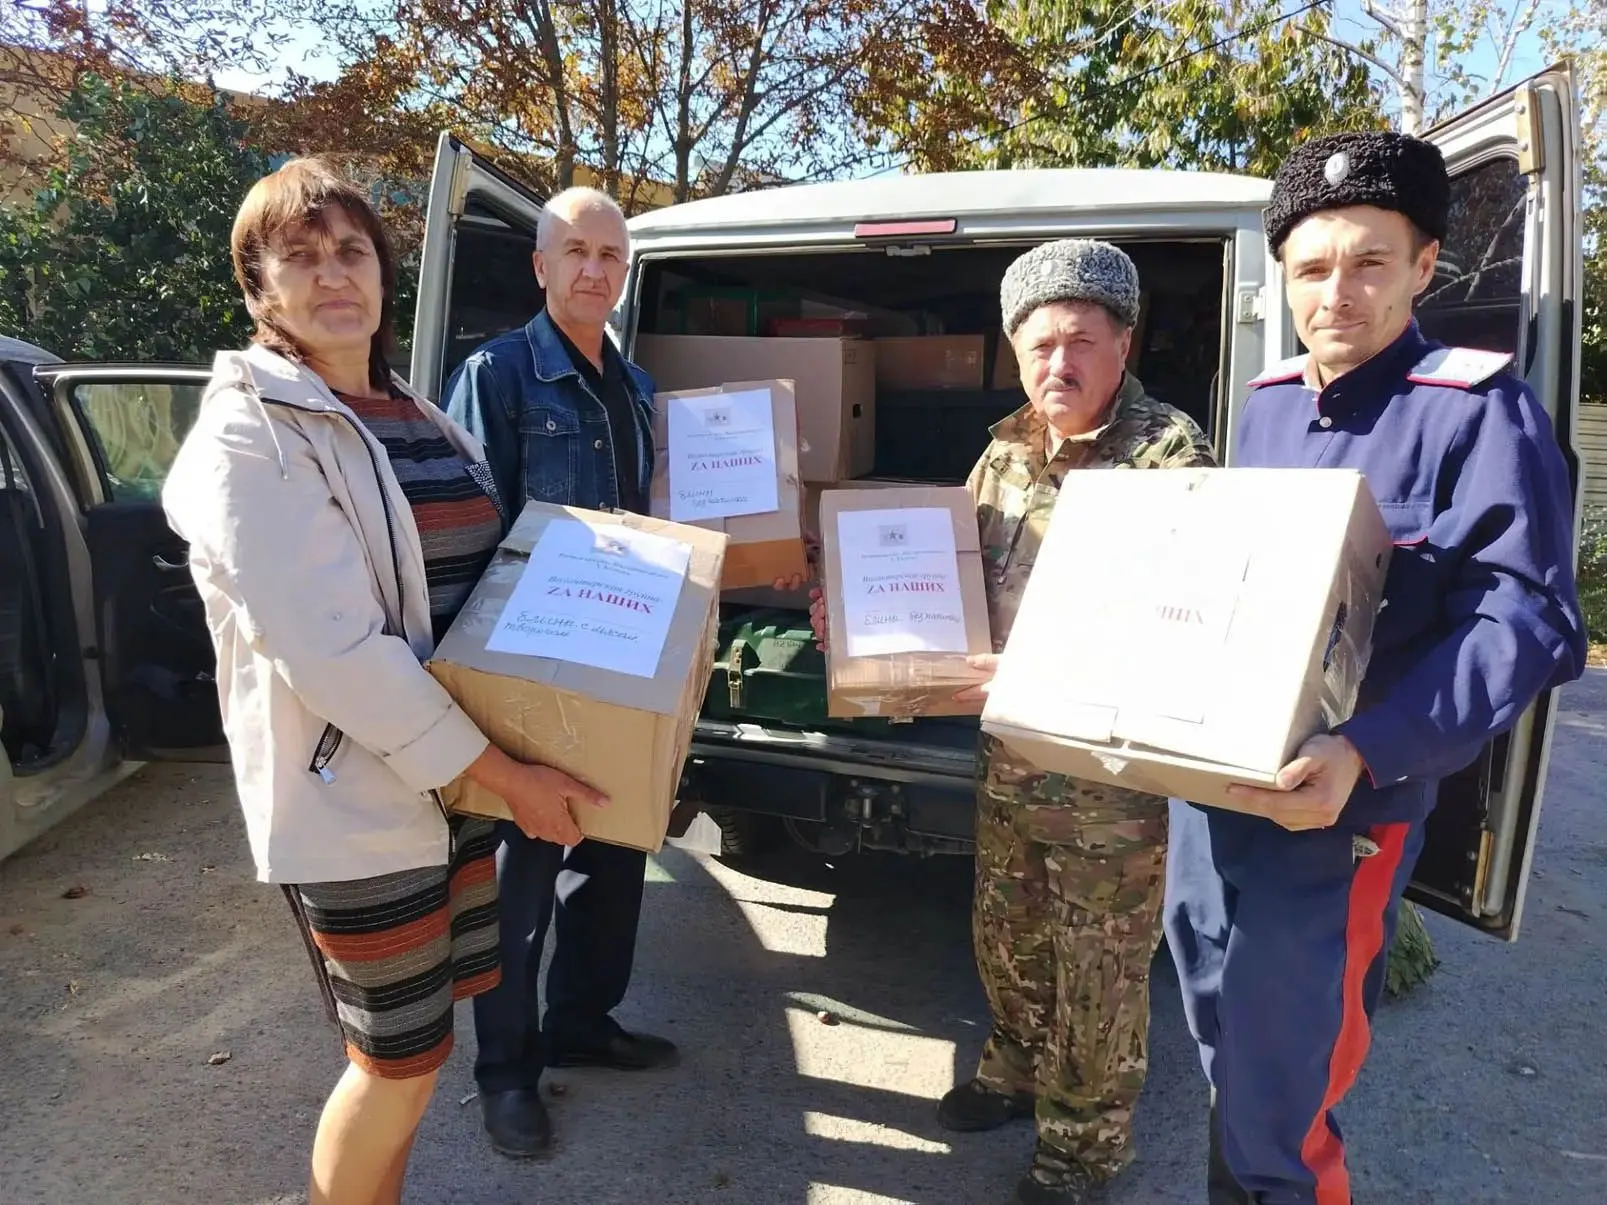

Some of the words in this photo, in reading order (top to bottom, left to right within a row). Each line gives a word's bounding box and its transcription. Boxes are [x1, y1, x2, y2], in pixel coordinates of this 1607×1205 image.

[690, 461, 707, 471] ZA
[711, 456, 762, 469] НАШИХ
[867, 584, 885, 594] ZA
[889, 581, 946, 593] НАШИХ
[547, 586, 571, 597] ZA
[578, 589, 653, 614] НАШИХ
